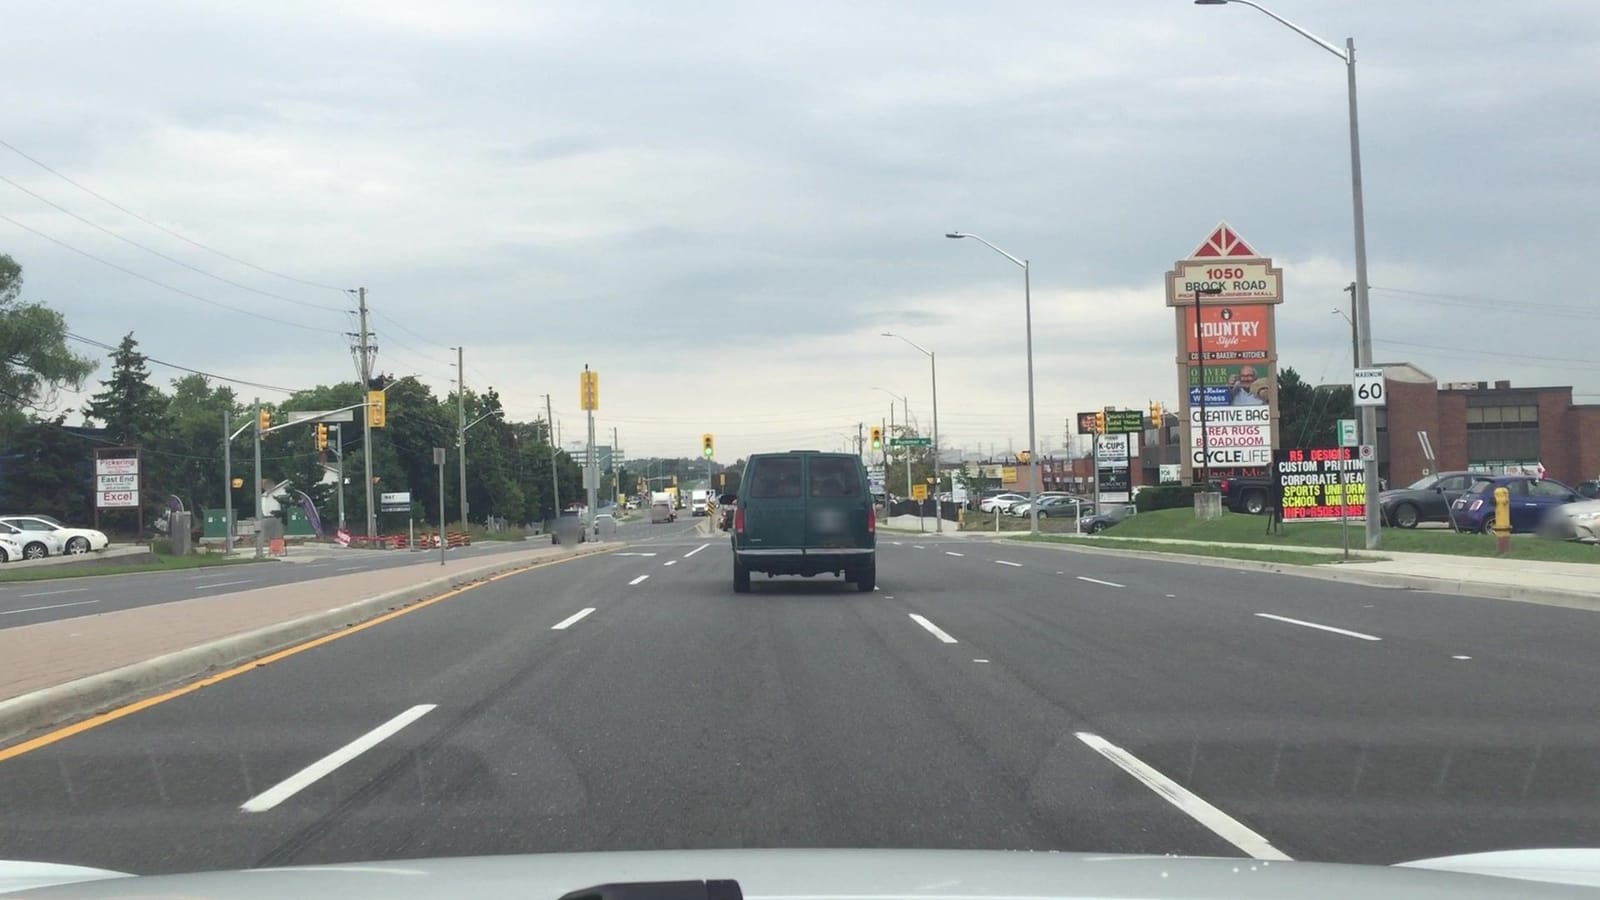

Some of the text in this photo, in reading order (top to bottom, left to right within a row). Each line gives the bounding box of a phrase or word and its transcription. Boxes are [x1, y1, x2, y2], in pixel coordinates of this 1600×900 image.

[1206, 268, 1243, 280] 1050
[1185, 280, 1266, 292] BROCK ROAD
[1194, 321, 1259, 338] COUNTRY
[1215, 336, 1239, 348] Style
[1191, 367, 1228, 377] OIVER
[1358, 383, 1383, 400] 60
[1193, 394, 1226, 403] Wllness
[1246, 409, 1269, 421] BAG
[1203, 425, 1260, 436] REA RUGS
[1099, 442, 1125, 450] K-CUPS
[1196, 437, 1264, 448] BOADLOOM
[1279, 459, 1365, 473] CUSTOM PRITIN
[1281, 472, 1337, 486] CORPORATE
[103, 491, 132, 501] Excel
[1284, 485, 1321, 497] SPORTS
[1282, 496, 1318, 508] SCHOOL
